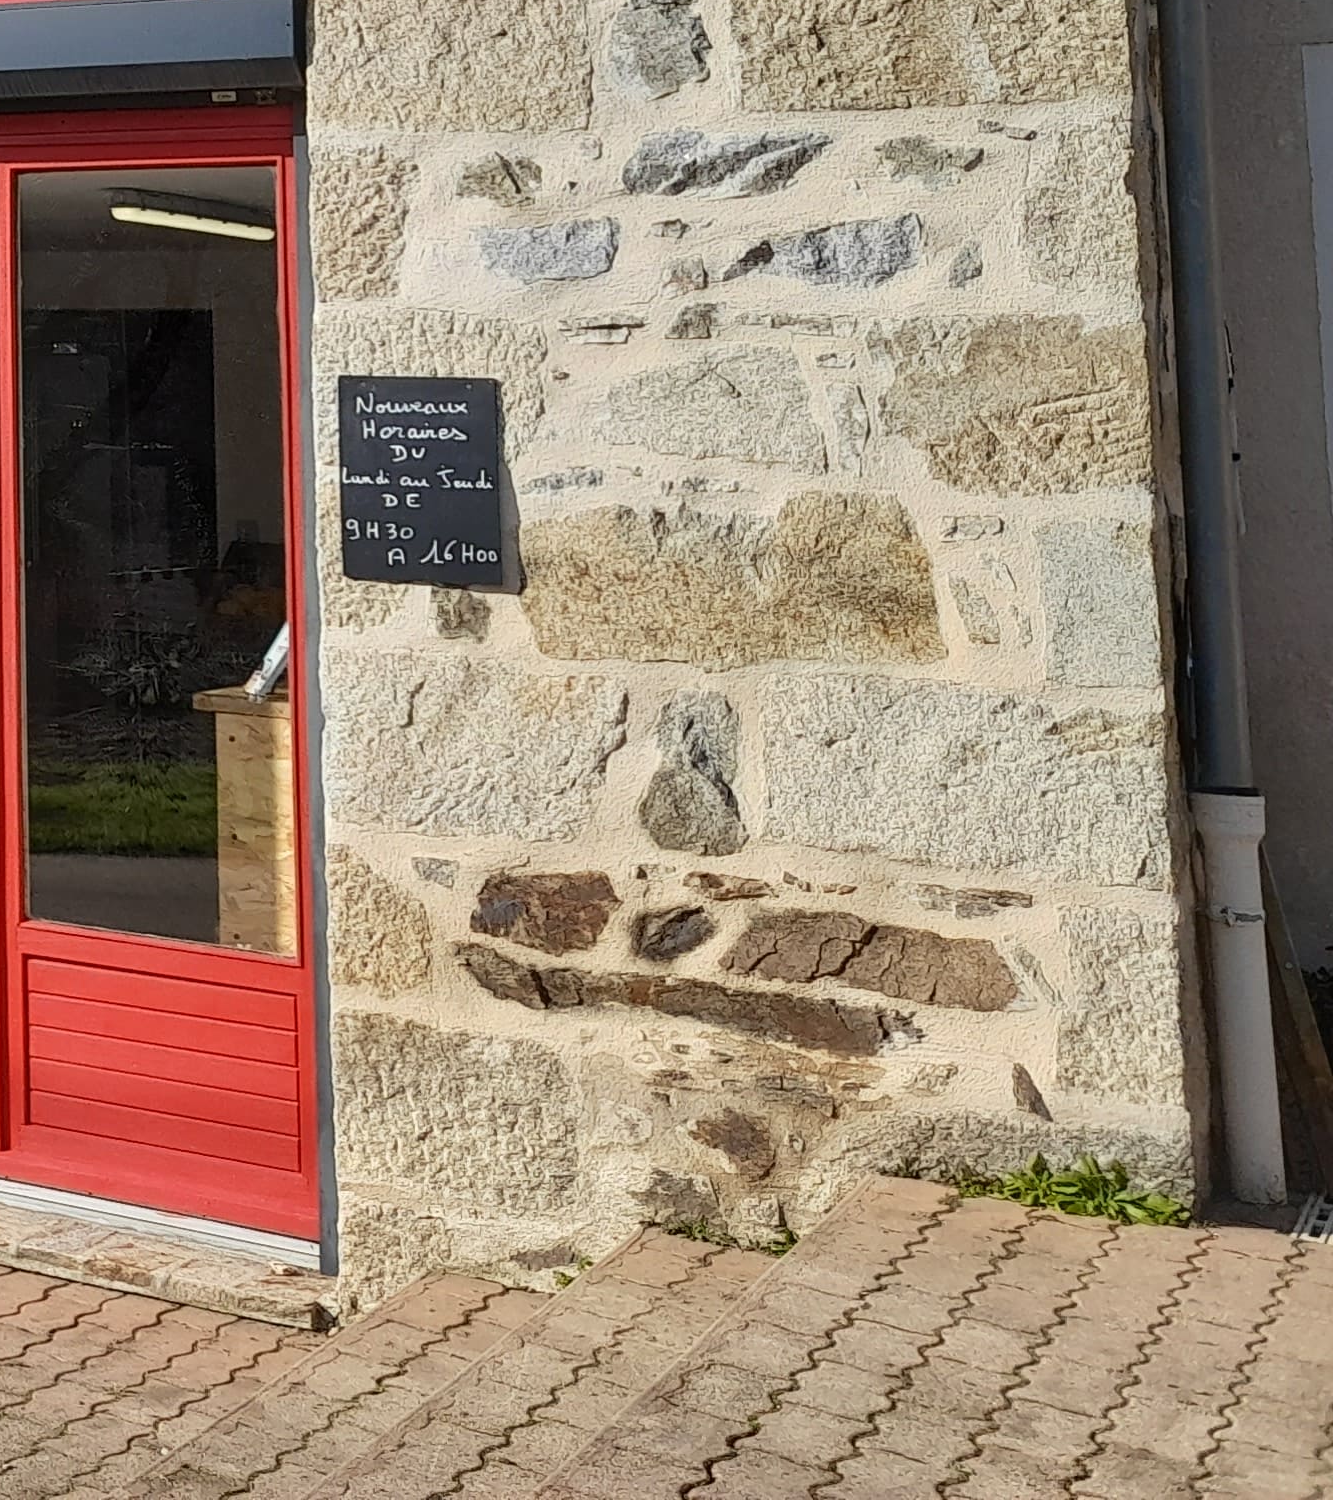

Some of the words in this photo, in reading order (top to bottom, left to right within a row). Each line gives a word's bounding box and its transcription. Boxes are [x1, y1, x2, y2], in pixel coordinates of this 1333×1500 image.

[355, 392, 468, 414] Nouveaux
[362, 419, 468, 441] Horaires
[389, 444, 426, 462] DU
[399, 475, 430, 488] au
[436, 466, 493, 490] Jeudi
[382, 493, 421, 508] DE
[387, 547, 406, 566] A
[420, 539, 498, 565] 16H00
